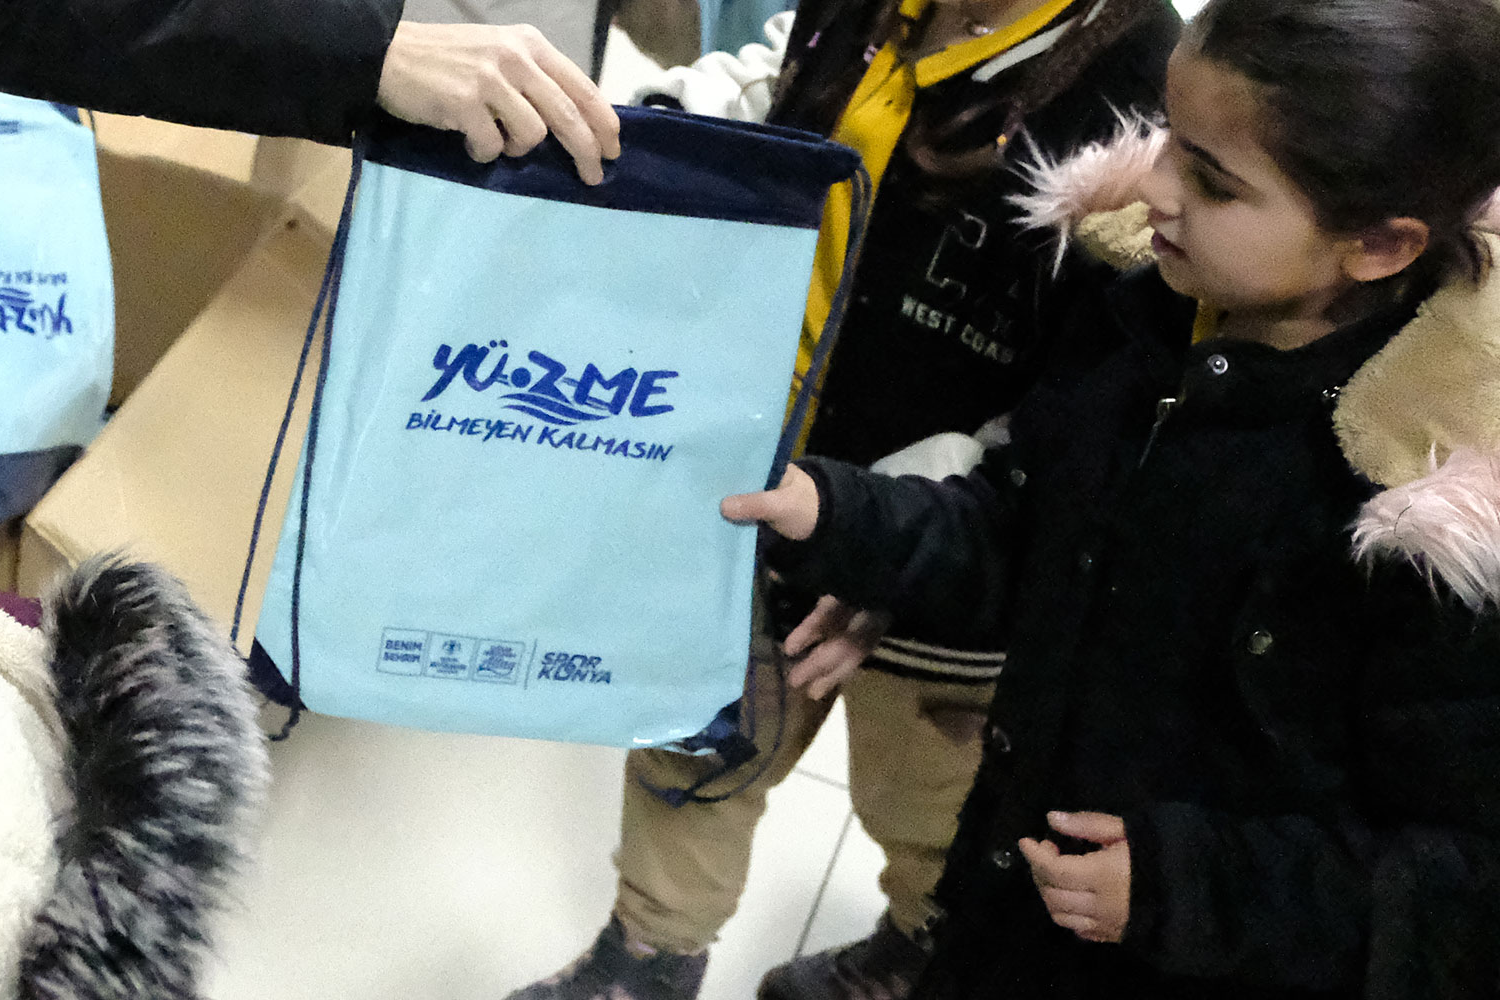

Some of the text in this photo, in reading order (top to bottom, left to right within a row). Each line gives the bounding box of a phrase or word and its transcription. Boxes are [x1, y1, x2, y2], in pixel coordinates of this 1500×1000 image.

[901, 293, 956, 334] WEST
[421, 340, 679, 417] YÜZME
[538, 427, 675, 462] KALMASIN
[537, 663, 612, 684] KONYA
[541, 652, 603, 669] SPOR
